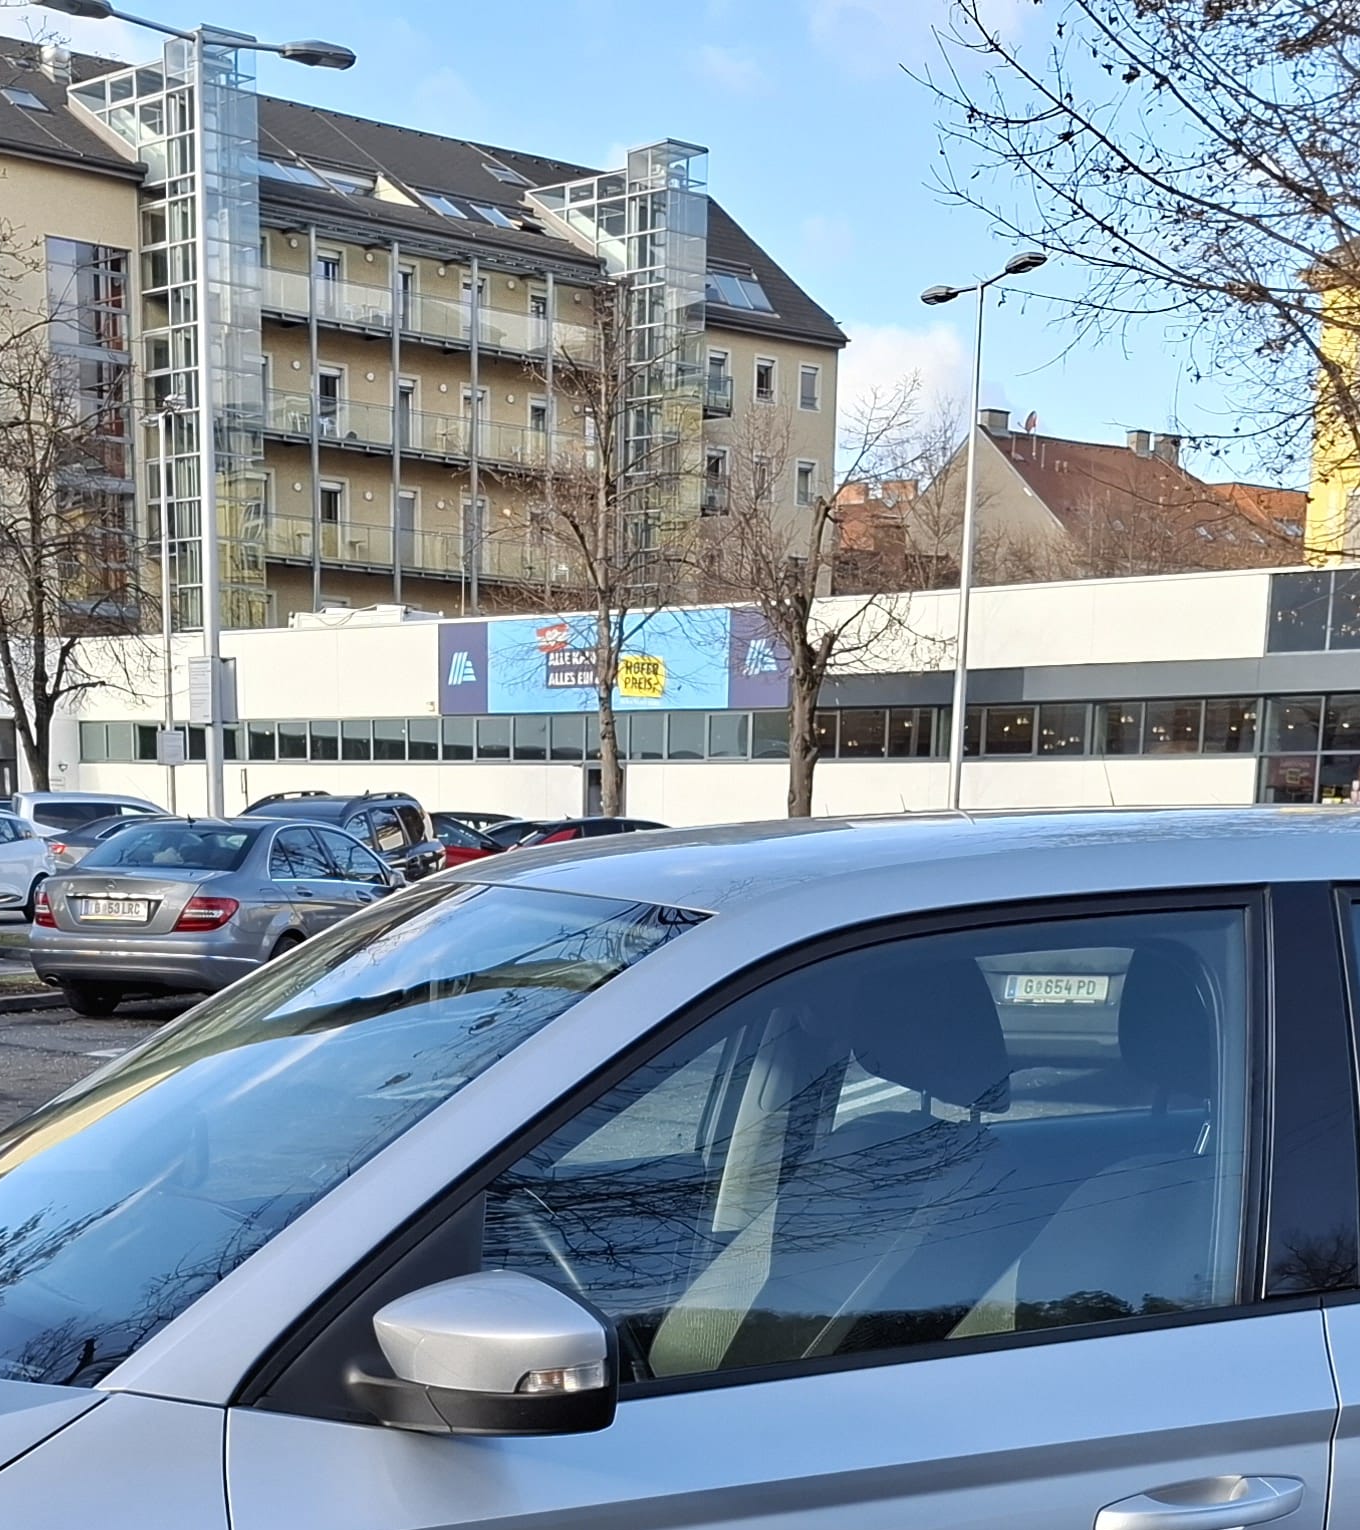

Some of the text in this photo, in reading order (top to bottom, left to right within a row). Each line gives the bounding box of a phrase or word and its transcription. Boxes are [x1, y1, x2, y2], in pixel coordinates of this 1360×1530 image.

[549, 652, 571, 666] ALLE
[625, 660, 659, 675] HOFER
[549, 672, 576, 686] ALLES
[1024, 978, 1097, 996] G 654 PD
